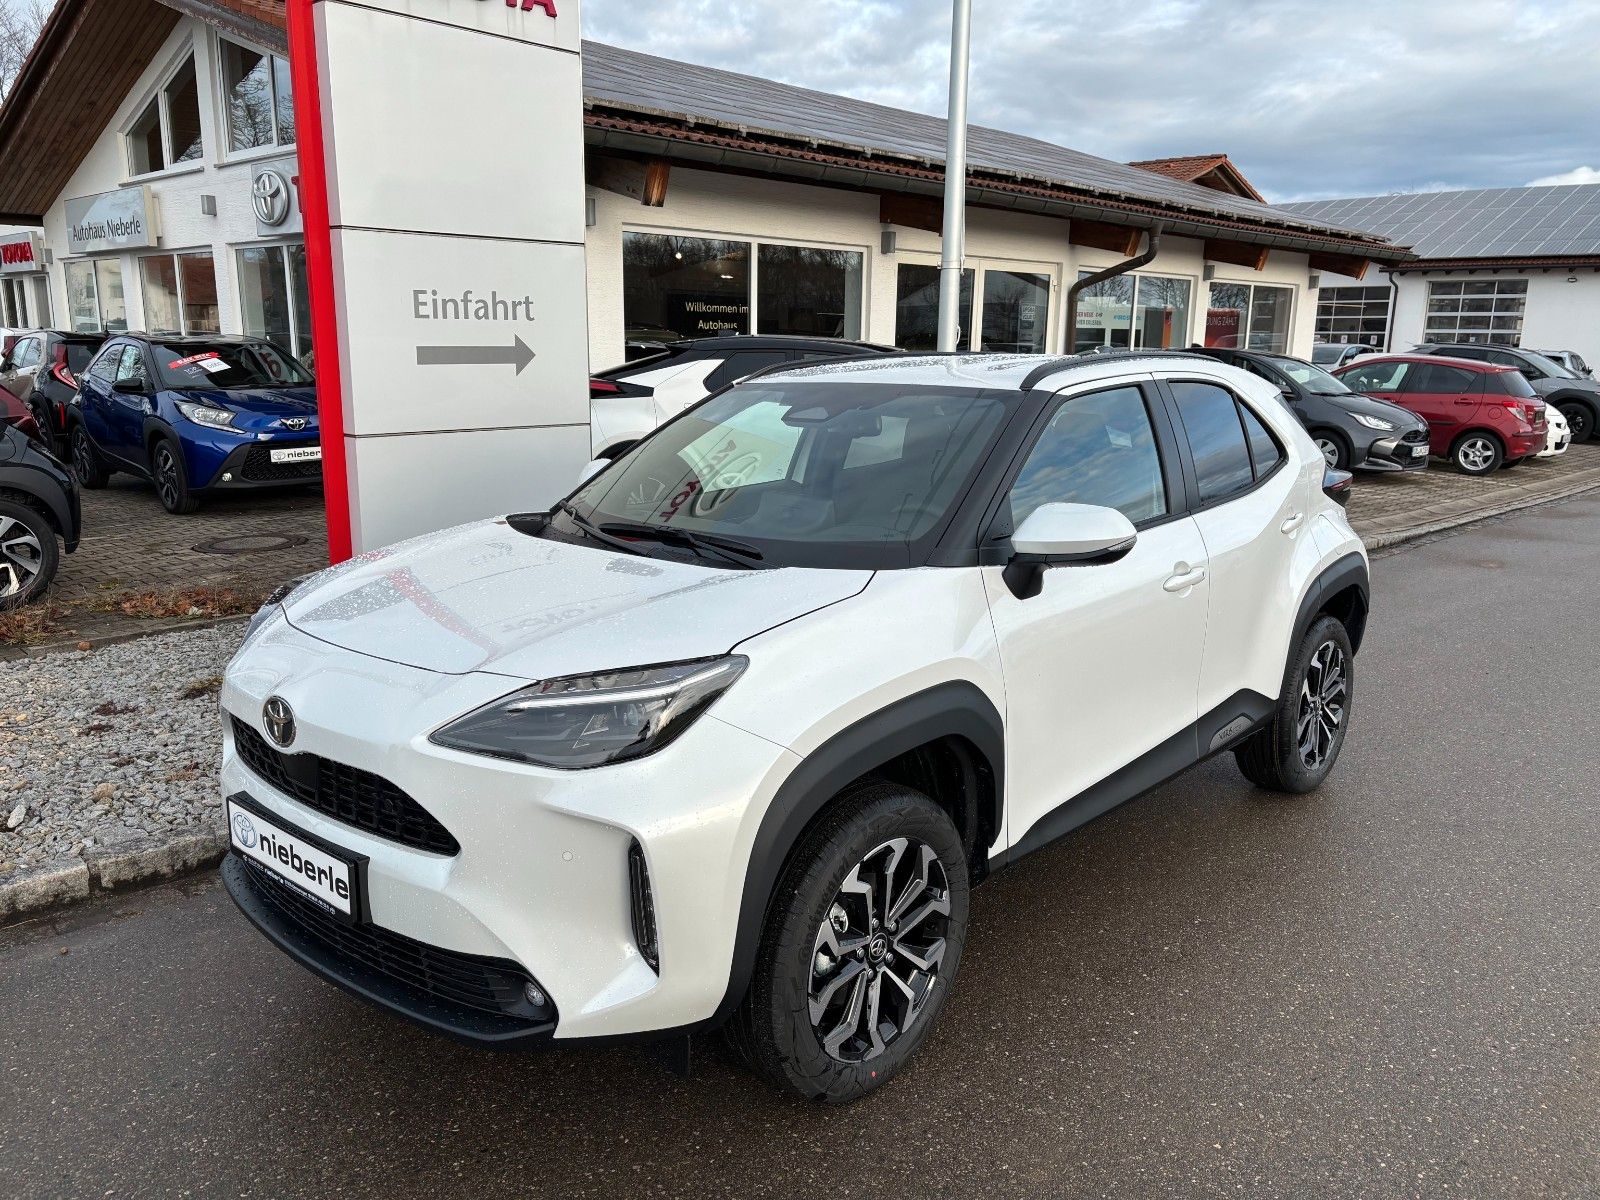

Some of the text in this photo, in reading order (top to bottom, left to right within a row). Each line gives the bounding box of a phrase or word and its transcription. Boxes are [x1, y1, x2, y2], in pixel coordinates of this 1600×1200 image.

[73, 215, 141, 241] Autohaus Nieberle
[412, 289, 535, 321] Einfahrt
[685, 301, 749, 313] Willkommen im
[697, 320, 738, 330] Autohaus
[260, 832, 349, 900] nieberle
